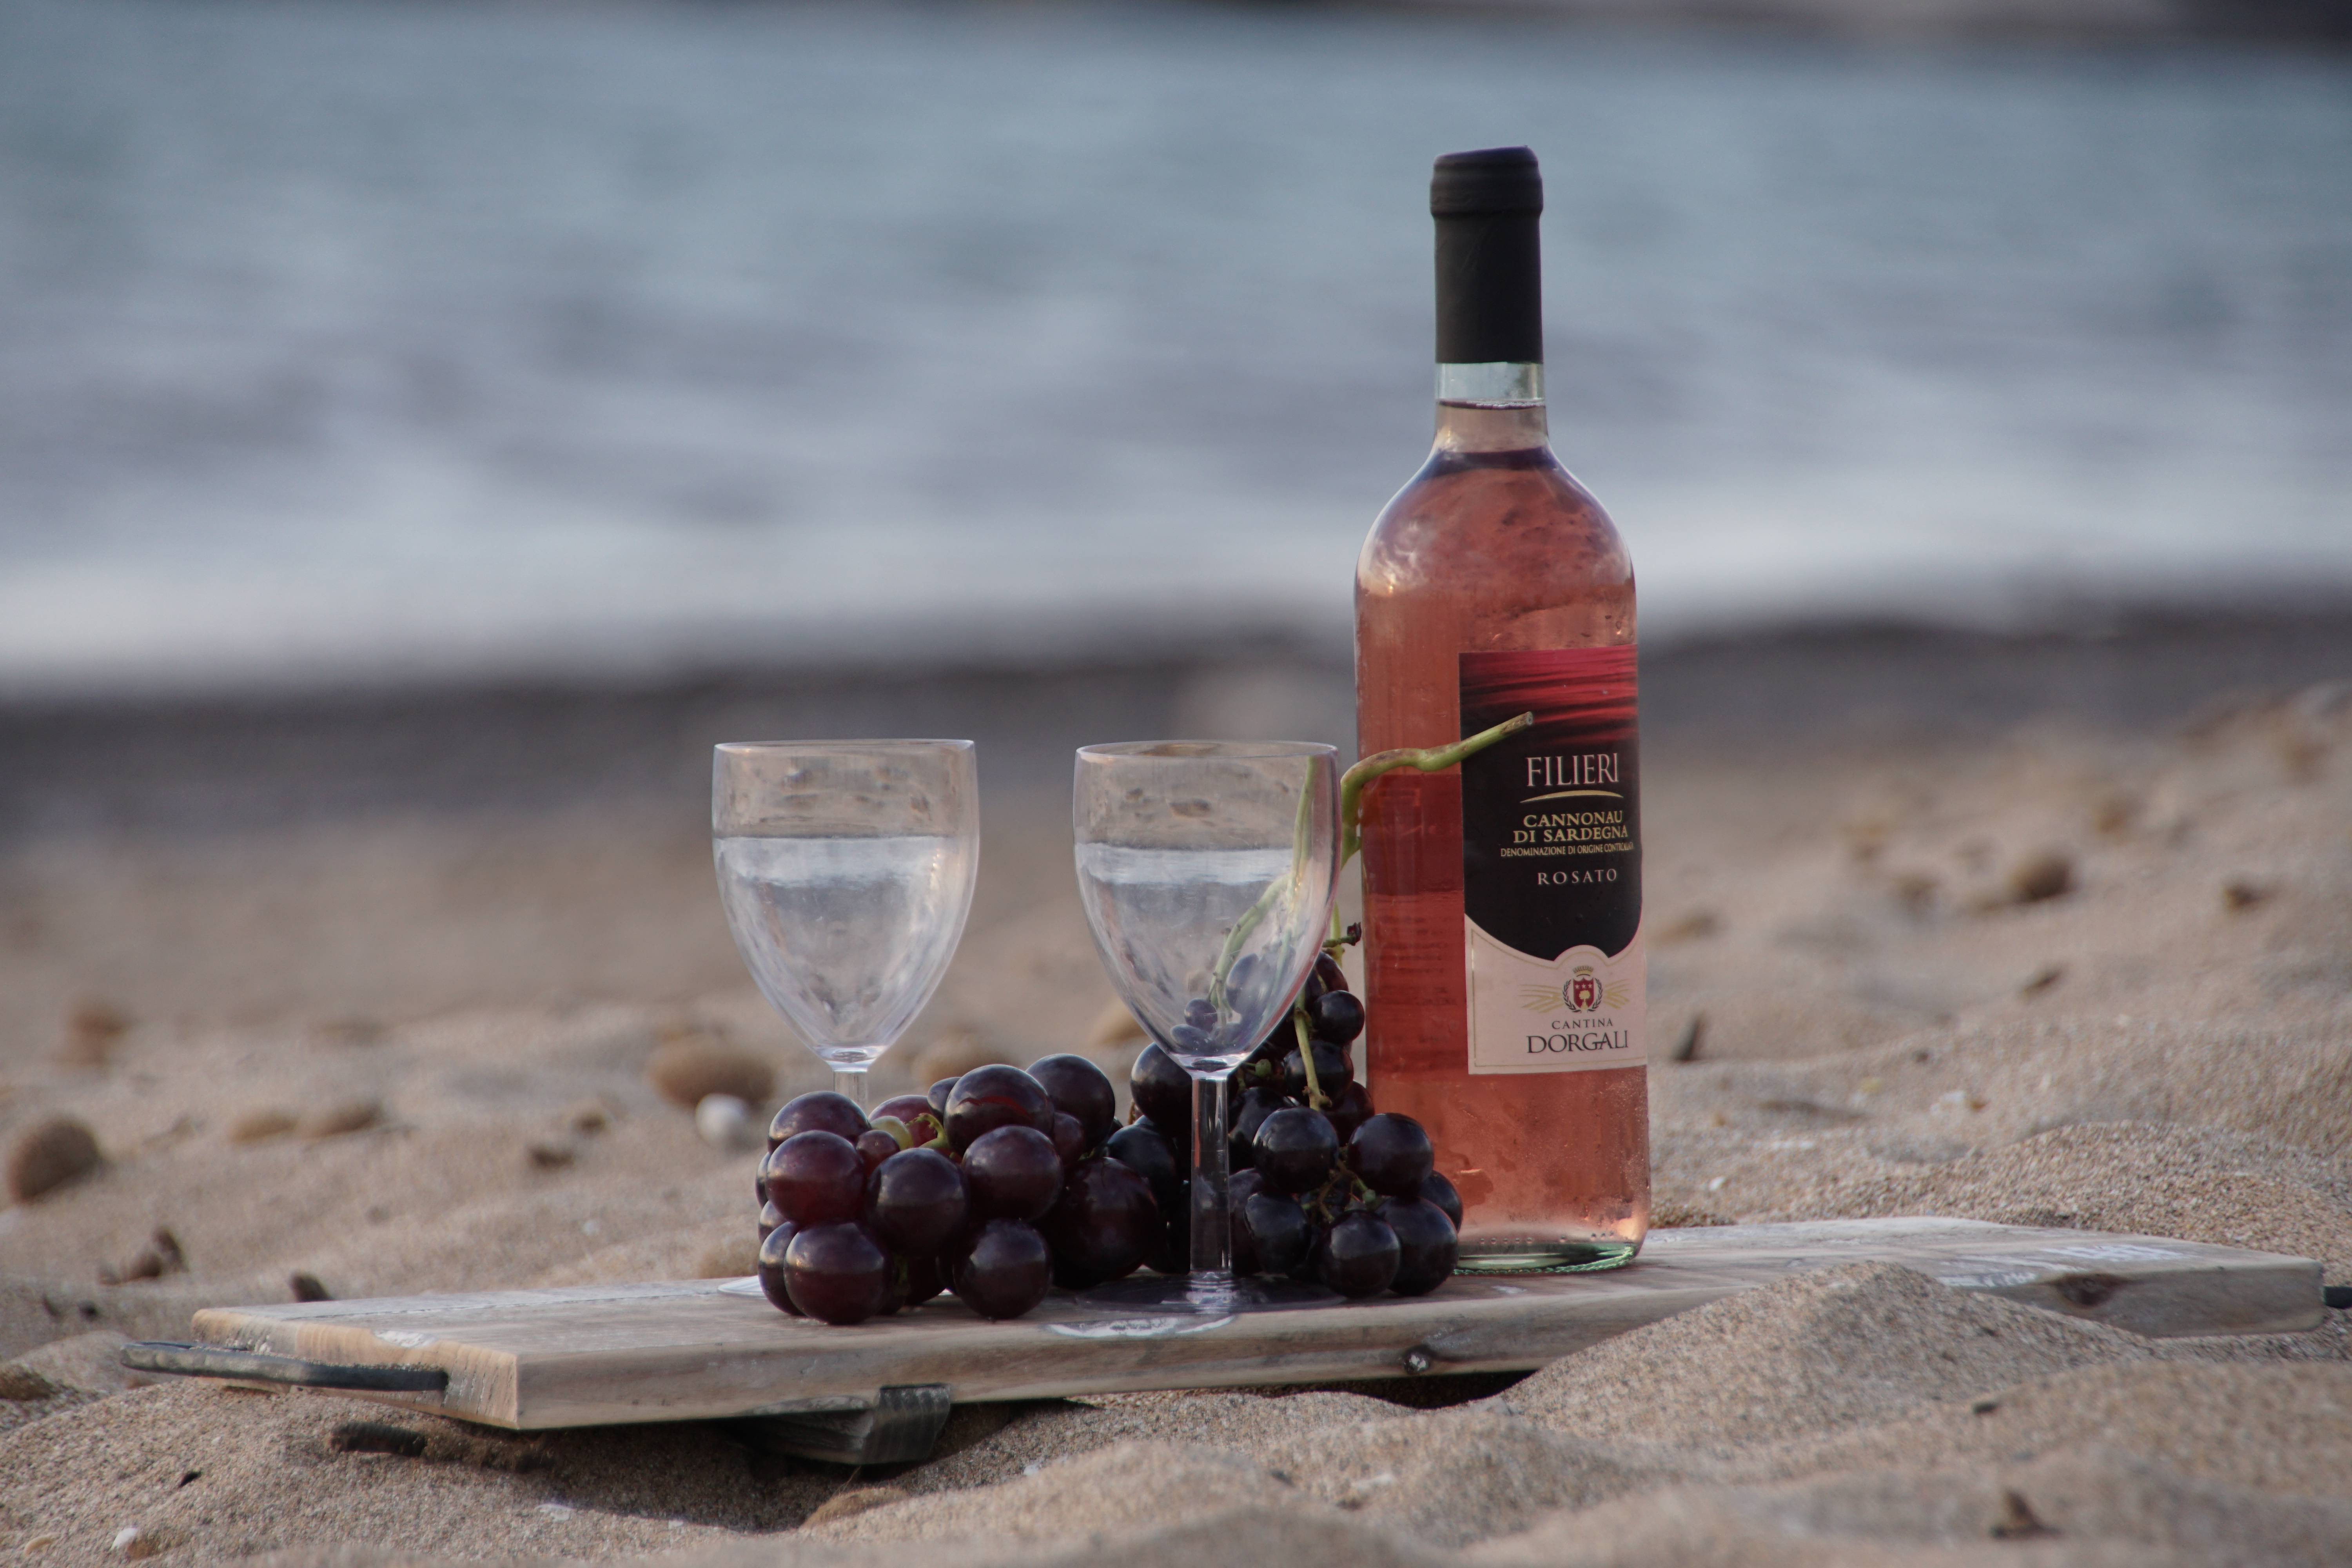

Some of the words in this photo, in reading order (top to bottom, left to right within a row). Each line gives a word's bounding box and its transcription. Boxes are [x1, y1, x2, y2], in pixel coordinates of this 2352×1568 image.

[1525, 753, 1619, 787] FILIERI
[1523, 810, 1623, 828] CANNONAU
[1513, 830, 1535, 843] DI
[1544, 825, 1628, 842] SARDEGNA
[1501, 846, 1566, 857] DENOMINAZIONE
[1568, 846, 1575, 854] DI
[1577, 844, 1603, 854] ORIGINE
[1537, 868, 1617, 885] ROSATO
[1552, 1018, 1613, 1029] CANTINA
[1526, 1030, 1628, 1053] DORGALI
